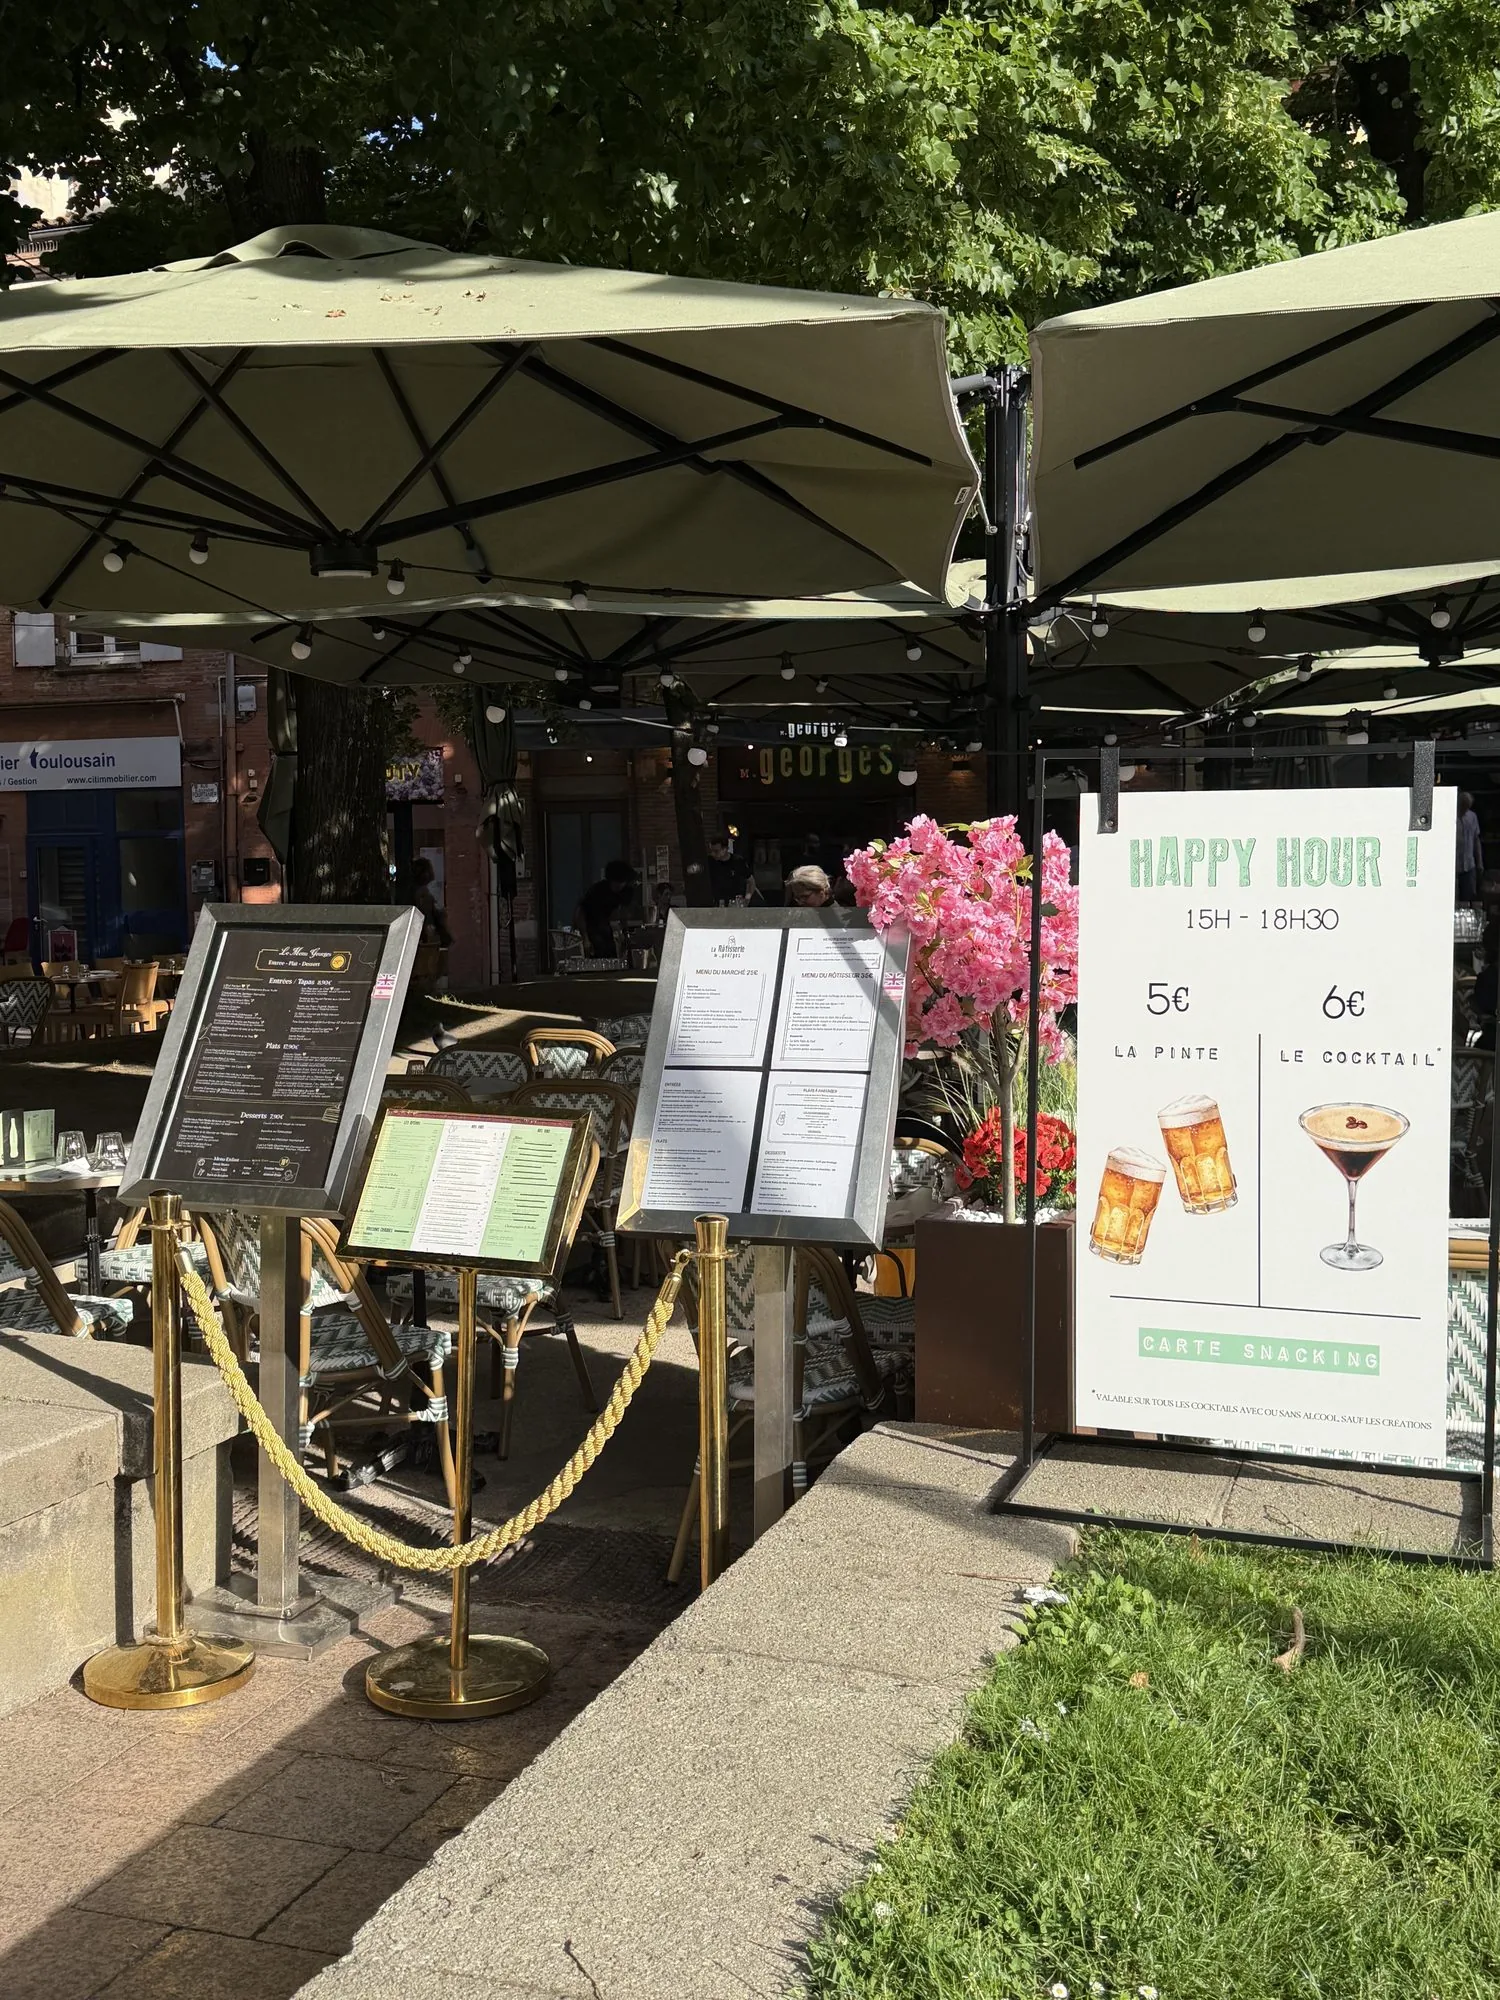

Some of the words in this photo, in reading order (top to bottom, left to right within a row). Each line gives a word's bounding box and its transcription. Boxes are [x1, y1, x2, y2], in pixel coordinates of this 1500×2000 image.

[8, 778, 37, 786] Gestion
[66, 775, 157, 785] www.citimmobilier.com
[1130, 836, 1256, 888] HAPPY
[1277, 836, 1381, 888] HOUR
[1406, 836, 1419, 888] !
[1187, 909, 1231, 930] 15H
[1261, 909, 1339, 931] 18H30
[1146, 983, 1190, 1015] 5€
[1322, 985, 1365, 1019] 6€
[1114, 1046, 1137, 1059] LA
[1154, 1046, 1219, 1061] PINTE
[1280, 1050, 1304, 1063] LE
[1142, 1336, 1221, 1357] CARTE
[1243, 1343, 1378, 1369] SNACKING
[1134, 1397, 1151, 1406] SUR
[1152, 1398, 1174, 1408] TOUS
[1175, 1400, 1190, 1409] LES
[1191, 1401, 1238, 1413] COCKTAILS
[1240, 1406, 1263, 1416] AVEC
[1264, 1408, 1279, 1417] OU
[1279, 1409, 1302, 1419] SANS
[1341, 1414, 1364, 1425] SAUF
[1365, 1416, 1381, 1426] LES
